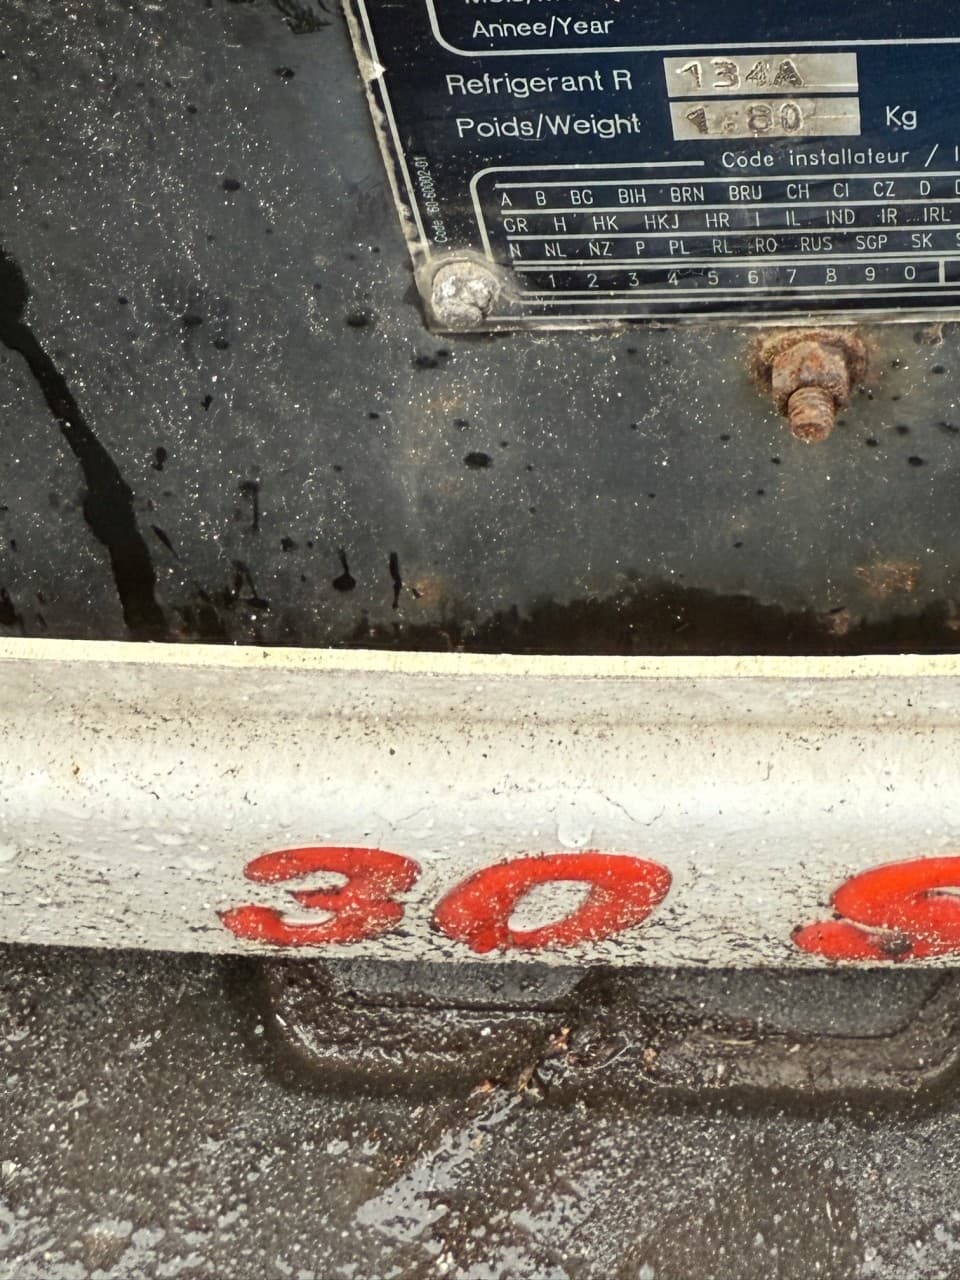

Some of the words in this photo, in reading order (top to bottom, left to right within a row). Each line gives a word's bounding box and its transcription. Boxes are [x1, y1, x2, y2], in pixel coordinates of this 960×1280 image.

[472, 16, 614, 39] Annee/Year
[446, 70, 604, 98] Refrigerant
[613, 69, 633, 91] R
[676, 57, 805, 89] 134A
[455, 113, 640, 139] Poids/Weight
[885, 106, 918, 130] Kg
[722, 150, 775, 168] Code
[789, 147, 910, 167] installateur
[618, 188, 647, 205] BIH
[670, 186, 705, 203] BRN
[729, 184, 762, 201] BRU
[786, 183, 810, 200] CH
[833, 182, 849, 198] CI
[873, 181, 896, 198] CZ
[592, 214, 619, 232] HK
[644, 213, 680, 231] HKJ
[705, 212, 730, 228] HR
[786, 210, 801, 227] IL
[825, 208, 856, 225] IND
[923, 206, 951, 223] IRL
[544, 241, 567, 258] NL
[588, 240, 613, 257] NZ
[668, 239, 691, 256] PL
[800, 236, 833, 252] RUS
[855, 234, 888, 250] SGP
[911, 232, 933, 249] SK
[219, 846, 672, 954] 30
